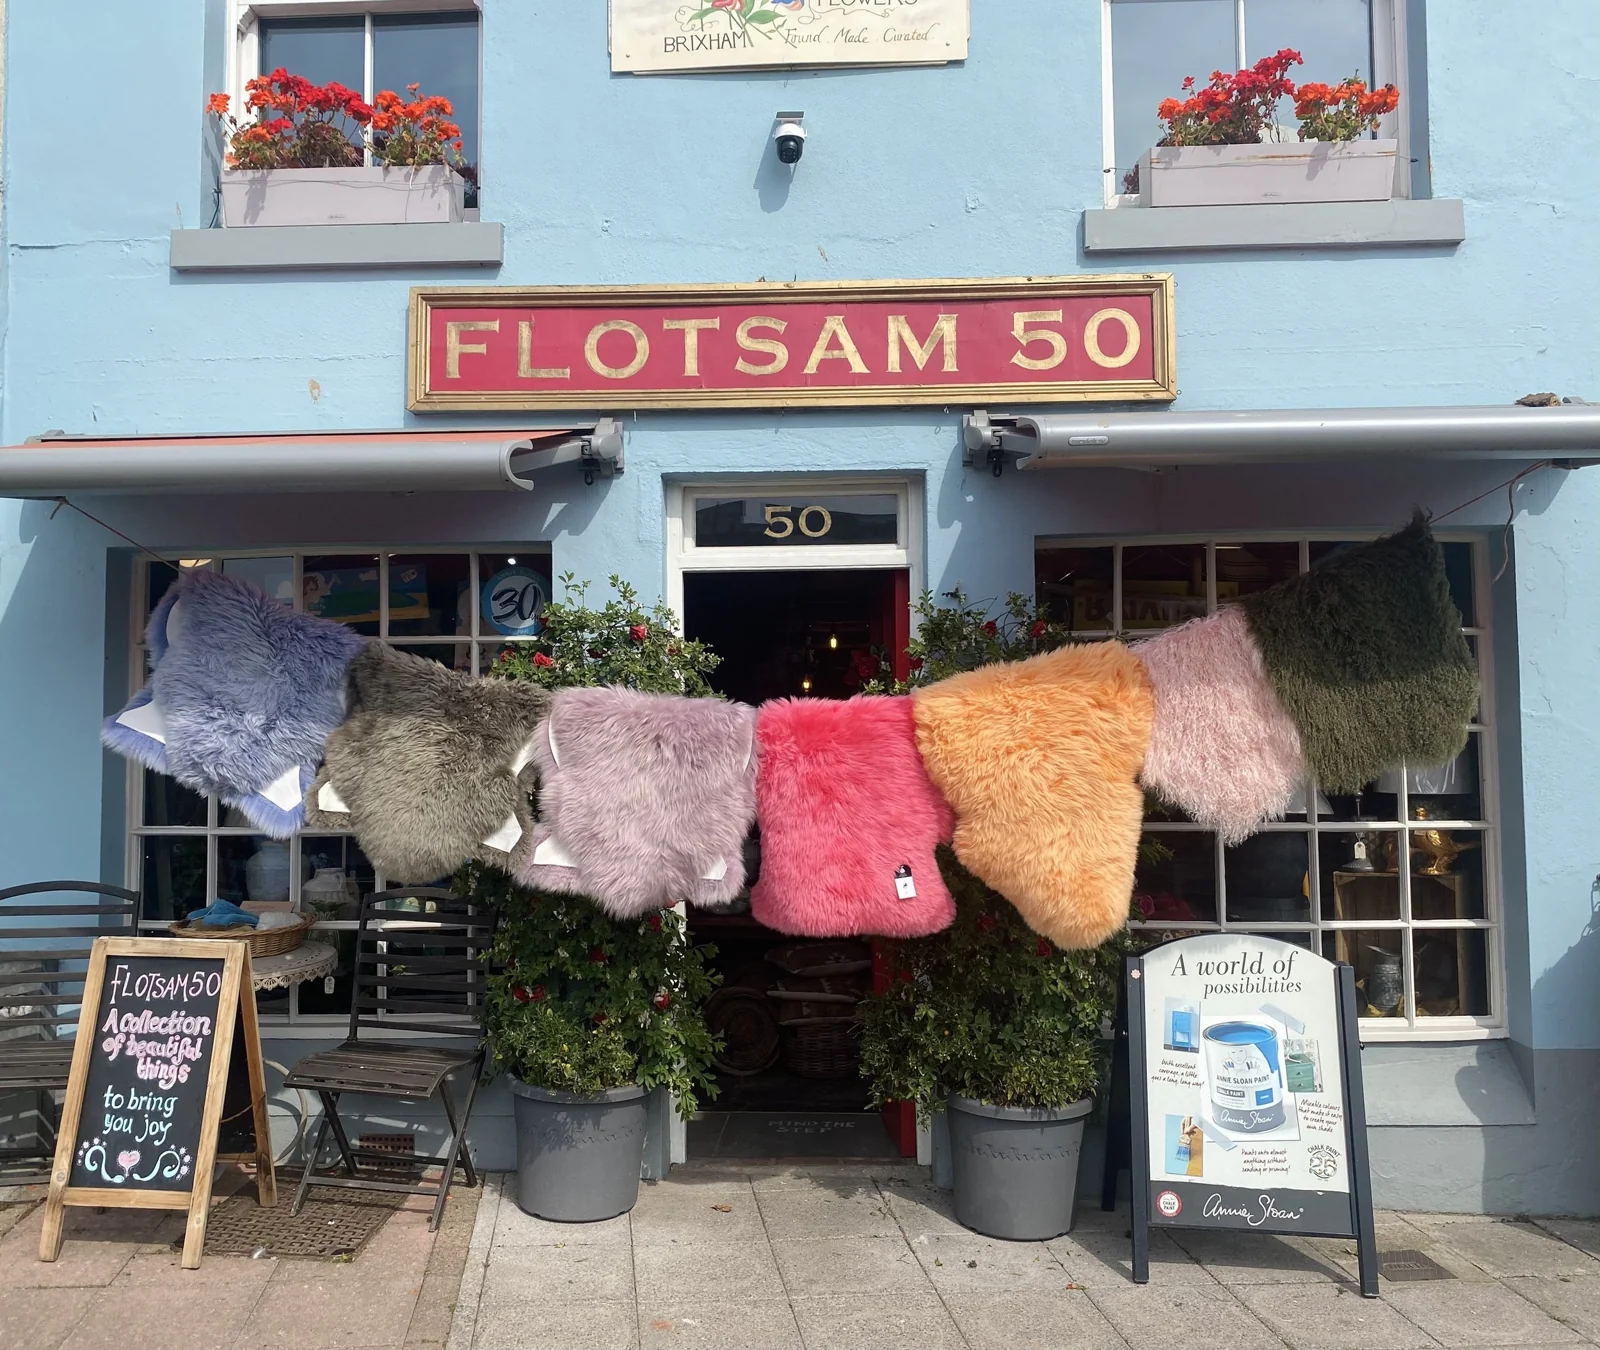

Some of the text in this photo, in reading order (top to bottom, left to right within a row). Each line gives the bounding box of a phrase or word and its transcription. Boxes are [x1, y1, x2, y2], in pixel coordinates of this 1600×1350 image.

[664, 31, 746, 53] BRIXHAM
[784, 22, 941, 44] Found Made Curated
[445, 307, 1141, 379] FLOTSAM 50
[763, 504, 832, 539] 50
[491, 582, 542, 624] 30
[1170, 950, 1299, 980] A world of
[1203, 976, 1302, 999] possibilities
[101, 1007, 119, 1034] A
[102, 1032, 203, 1066] of beautiful
[136, 1056, 191, 1090] things
[1232, 1077, 1253, 1085] SLOAN
[1253, 1074, 1270, 1084] PAINT
[103, 1084, 178, 1118] to bring
[102, 1113, 173, 1146] you joy
[1307, 1144, 1342, 1158] CHALK PAINT
[1202, 1193, 1301, 1226] Annie Sloan
